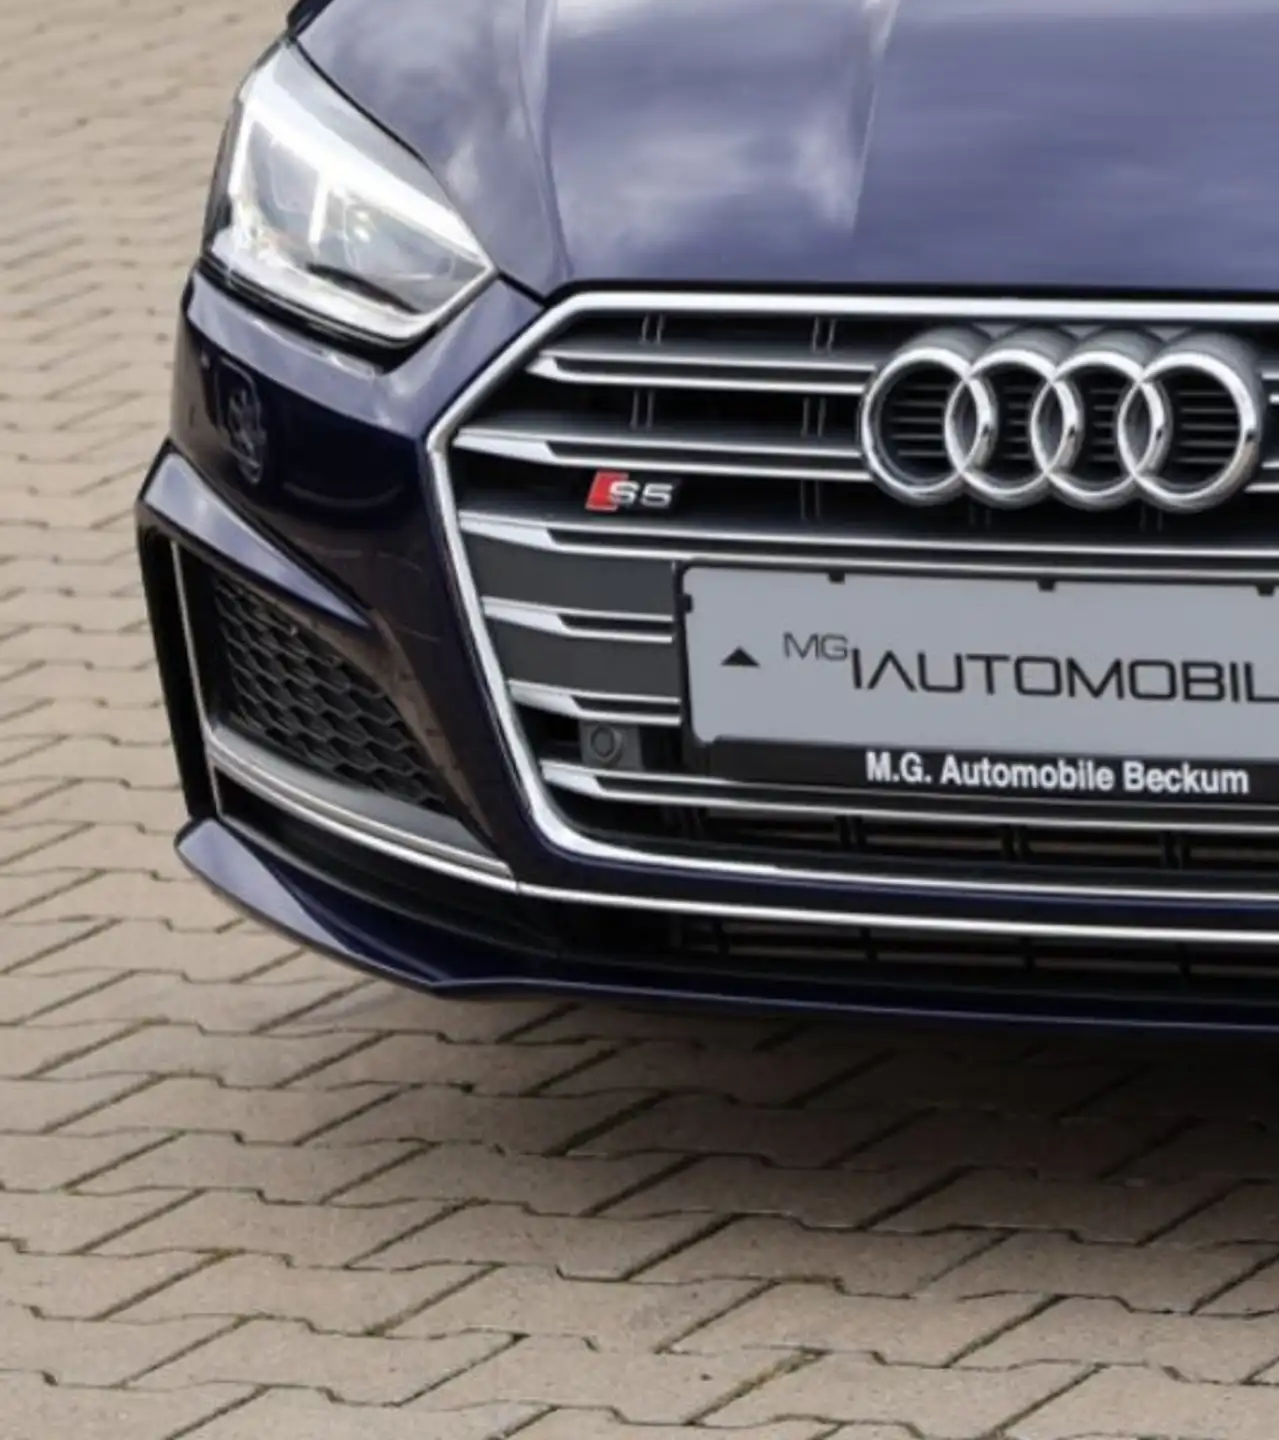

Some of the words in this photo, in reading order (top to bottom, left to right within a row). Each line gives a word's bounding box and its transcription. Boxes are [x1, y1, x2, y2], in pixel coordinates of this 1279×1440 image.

[609, 480, 673, 509] S5
[866, 751, 931, 784] M.G.
[940, 754, 1114, 791] Automobile
[1122, 761, 1249, 795] Beckum
